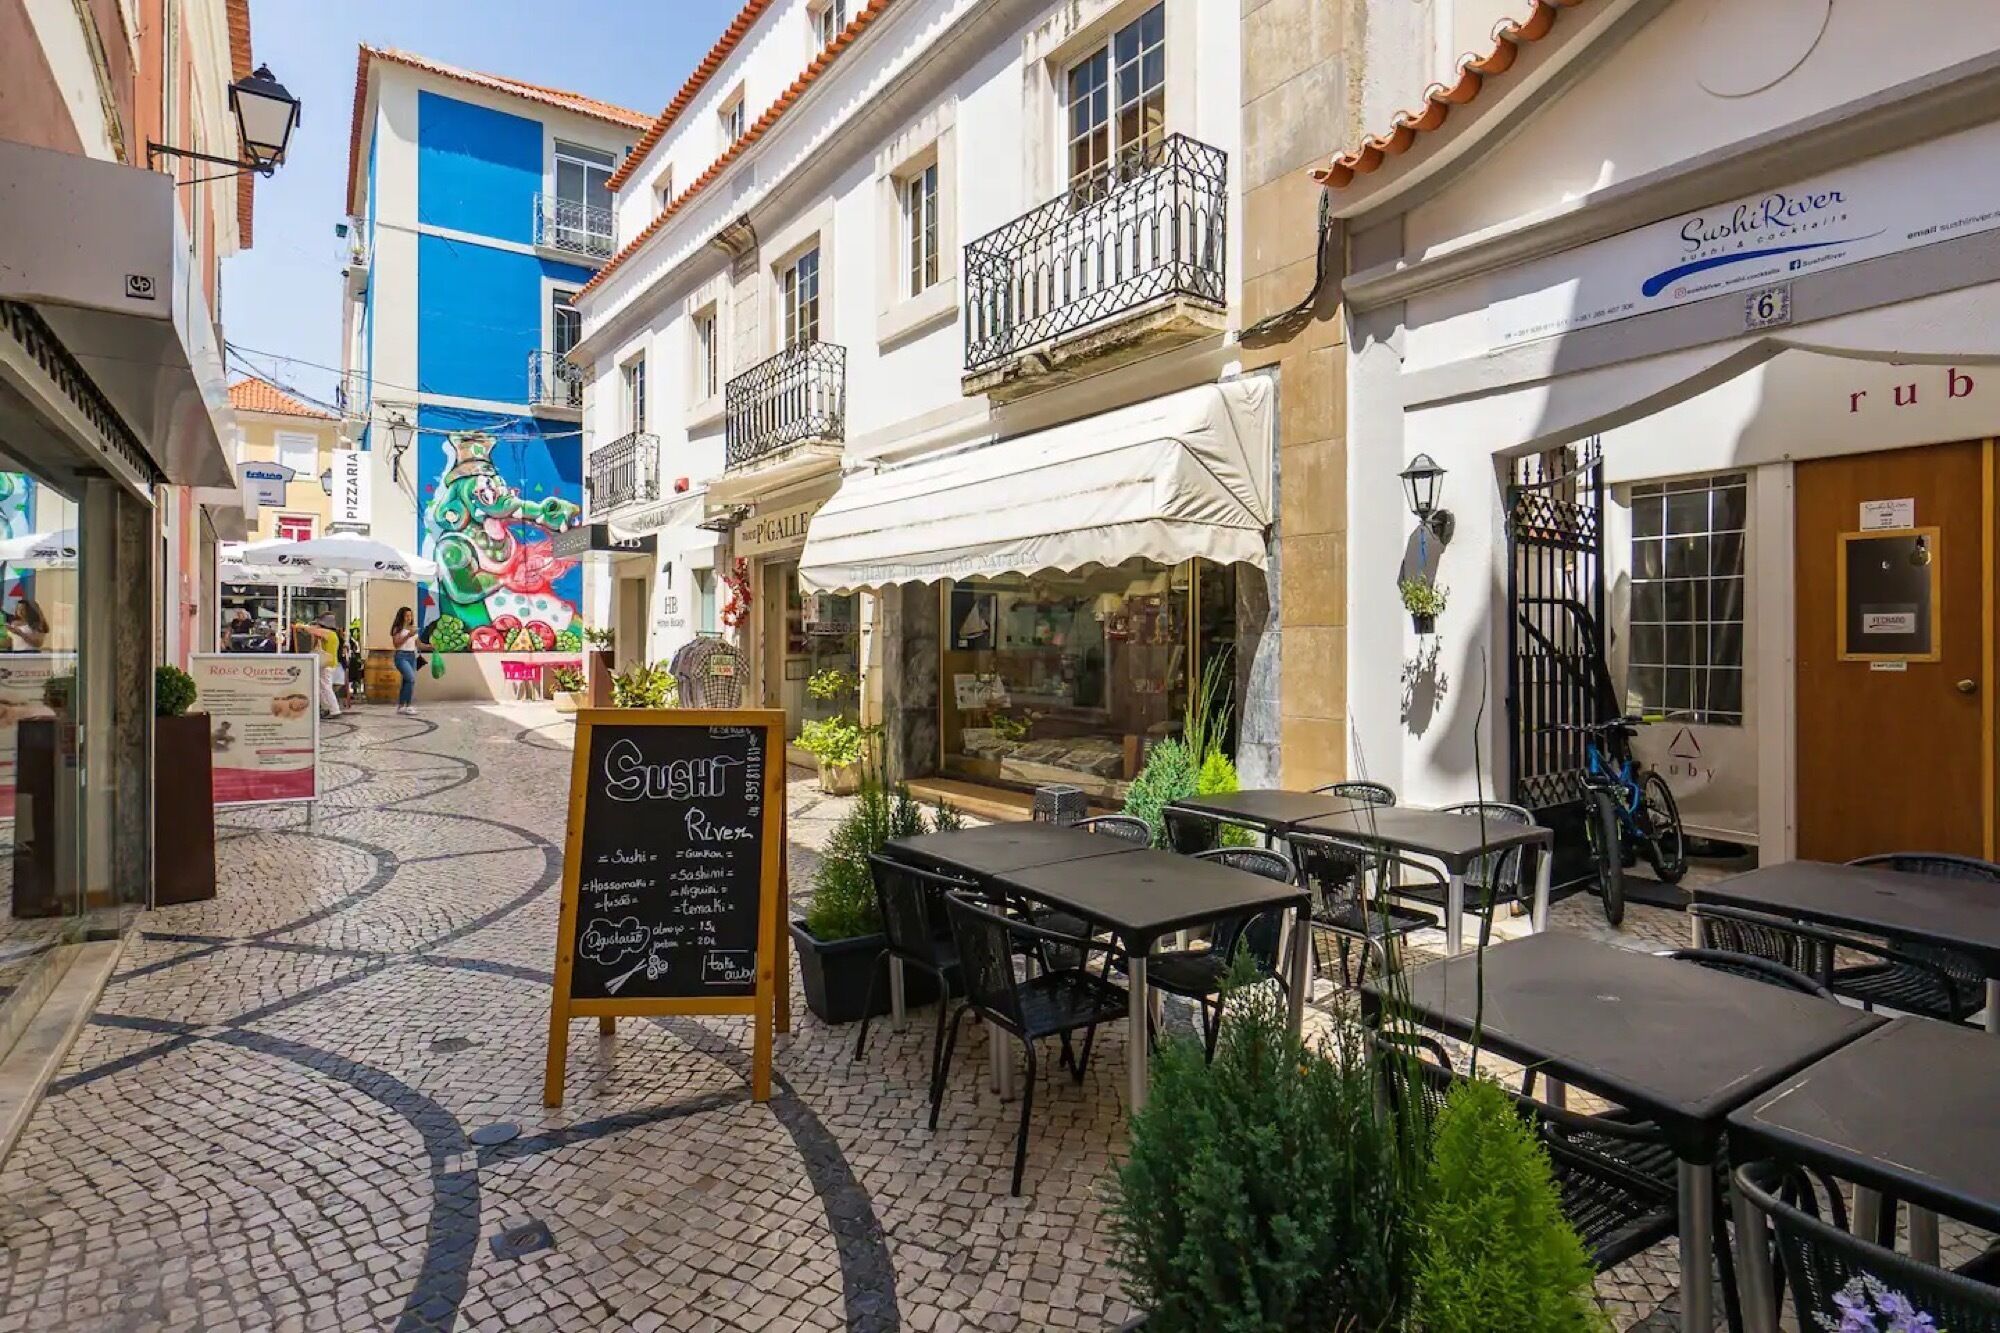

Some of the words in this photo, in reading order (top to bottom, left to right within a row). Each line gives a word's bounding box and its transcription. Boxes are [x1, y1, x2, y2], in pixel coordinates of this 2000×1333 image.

[1681, 246, 1725, 262] sushi
[1757, 214, 1848, 244] cocktails
[1907, 225, 1937, 240] email
[1758, 293, 1775, 319] 6
[346, 452, 358, 520] PIZZARIA
[664, 596, 679, 615] HB
[1650, 762, 1716, 782] ruby
[611, 849, 647, 865] Sushi
[677, 865, 725, 881] Sashimi
